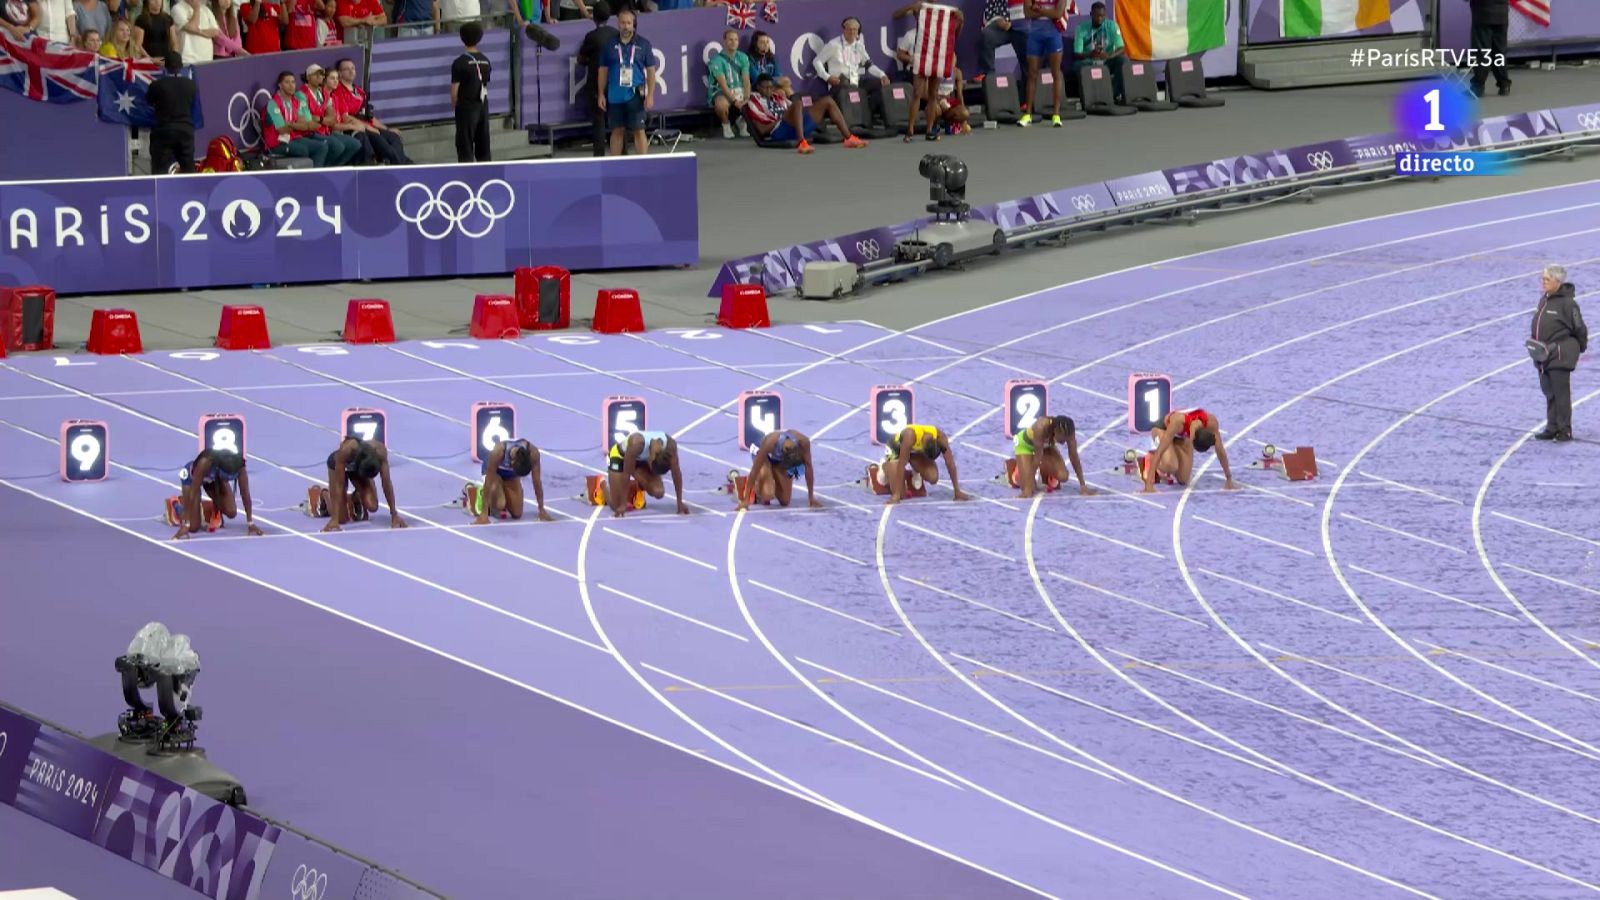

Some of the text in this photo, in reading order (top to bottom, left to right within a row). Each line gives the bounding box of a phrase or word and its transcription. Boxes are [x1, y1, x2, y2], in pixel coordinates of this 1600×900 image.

[181, 195, 342, 241] 2024
[751, 406, 775, 436] 4
[881, 399, 907, 435] 3
[1016, 393, 1041, 429] 2
[1144, 388, 1161, 423] 1
[212, 428, 239, 454] 8
[353, 422, 378, 441] 7
[482, 415, 511, 452] 6
[614, 409, 639, 442] 5
[71, 429, 101, 471] 9
[65, 774, 99, 808] 2024
